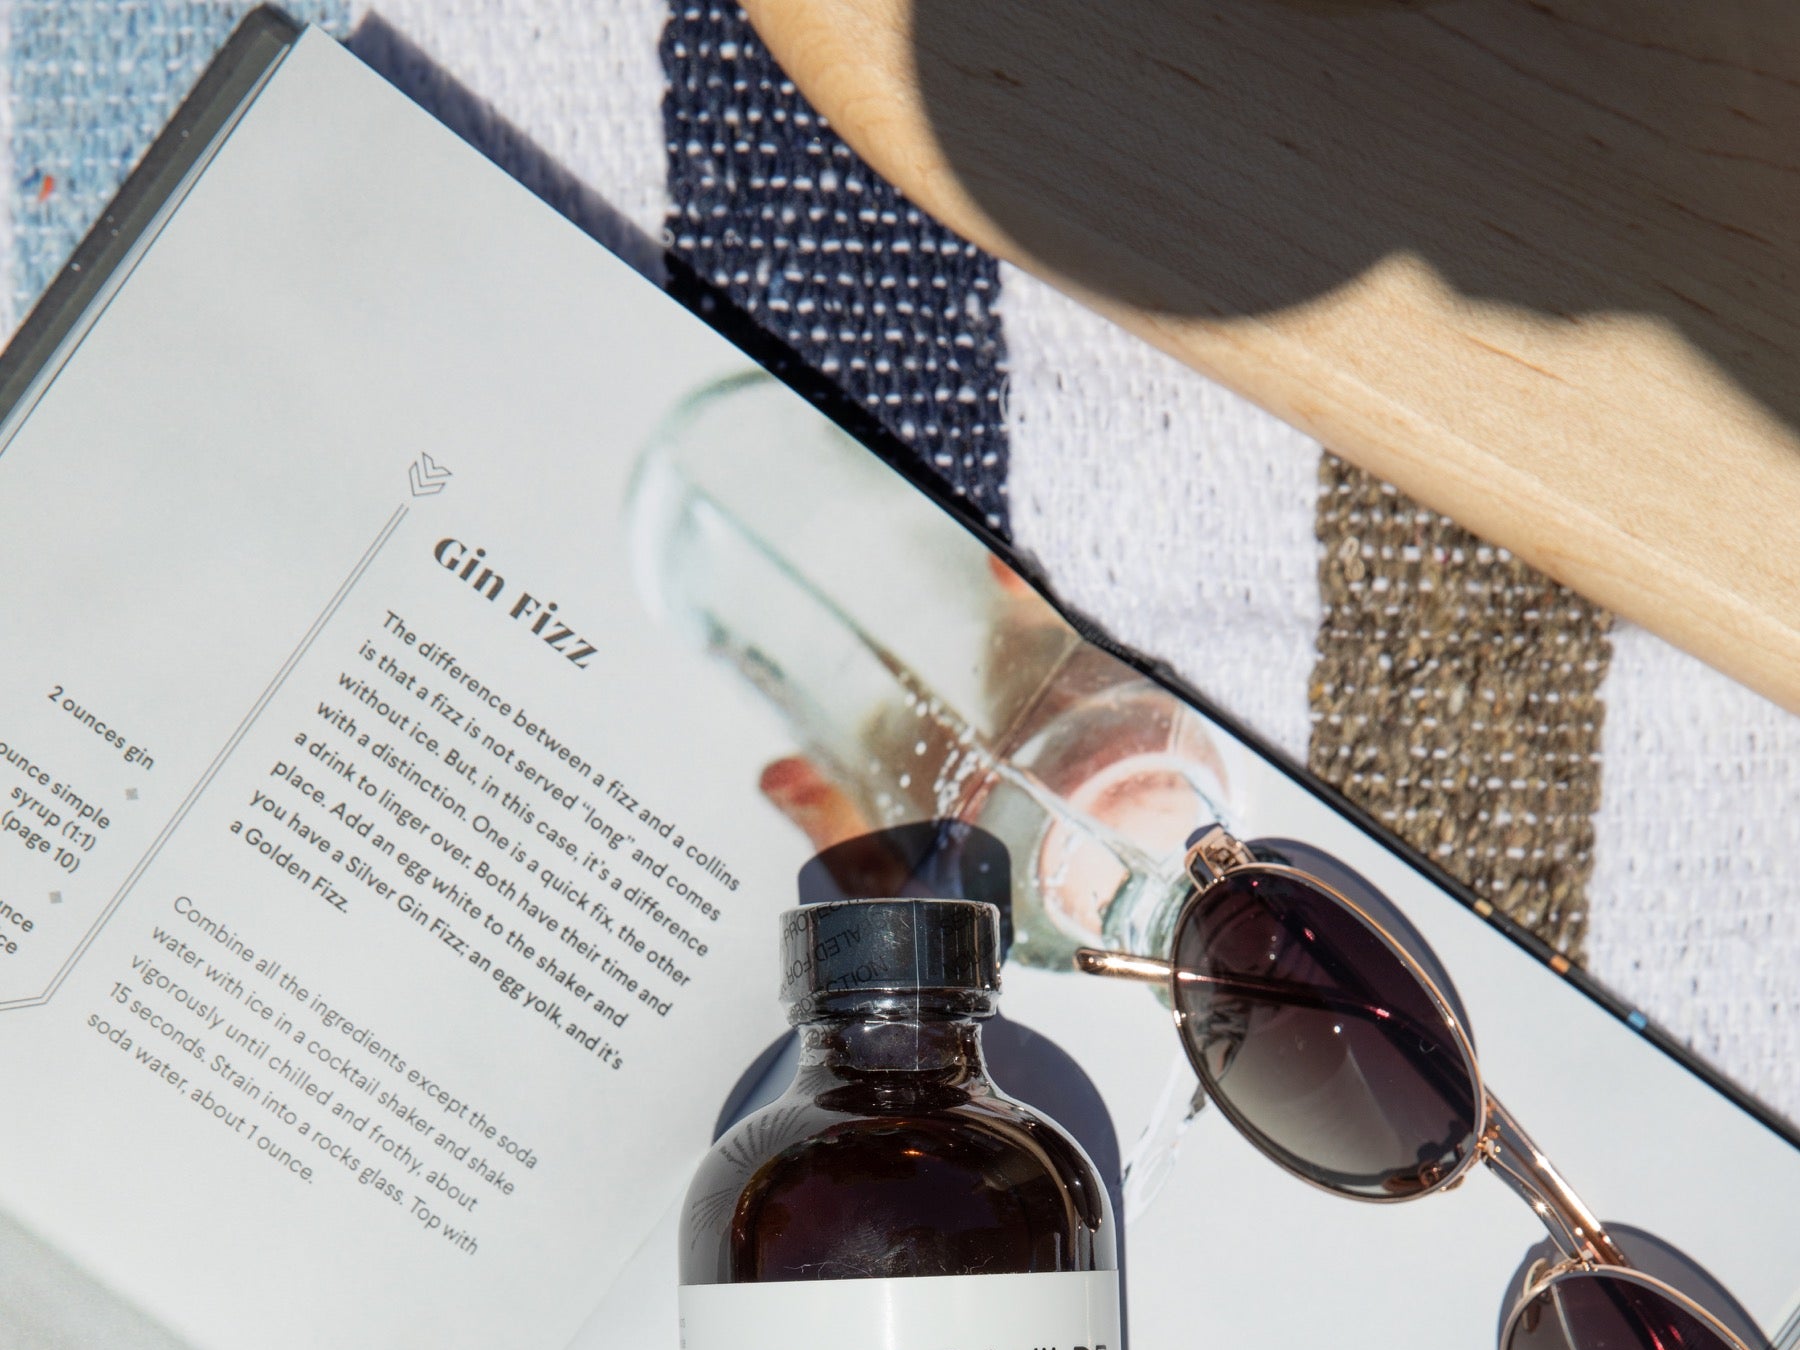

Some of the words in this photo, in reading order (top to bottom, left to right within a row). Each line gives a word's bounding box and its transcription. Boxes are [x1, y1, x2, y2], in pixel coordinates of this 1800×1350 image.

[47, 684, 64, 703] 2
[61, 698, 127, 750] ounces
[123, 745, 155, 771] gin
[433, 537, 505, 603] Gin
[508, 592, 599, 670] Fizz
[1, 810, 51, 853] (page
[52, 847, 81, 874] 10)
[10, 786, 61, 828] syrup
[61, 820, 97, 852] (1:1)
[51, 782, 110, 830] simple
[229, 820, 244, 835] a
[244, 827, 311, 884] Golden
[310, 875, 349, 914] Fizz.
[294, 732, 308, 747] a
[308, 742, 357, 783] drink
[356, 775, 378, 798] to
[378, 788, 431, 835] linger
[429, 832, 473, 870] over.
[473, 860, 517, 902] Both
[516, 891, 559, 932] have
[559, 926, 602, 963] their
[600, 957, 639, 993] time
[637, 988, 674, 1018] and
[317, 701, 358, 738] with
[356, 733, 371, 748] a
[371, 743, 467, 822] distinction.
[472, 814, 510, 850] One
[509, 841, 527, 864] is
[526, 859, 540, 874] a
[540, 869, 590, 912] quick
[589, 902, 614, 934] fix,
[617, 924, 646, 954] the
[645, 949, 691, 987] other
[338, 672, 410, 732] without
[408, 721, 440, 757] ice.
[443, 747, 478, 786] But,
[480, 774, 500, 799] in
[501, 791, 536, 825] this
[536, 821, 578, 862] case,
[609, 877, 623, 892] a
[623, 887, 709, 957] difference
[358, 639, 377, 662] is
[377, 654, 417, 692] that
[415, 686, 429, 701] a
[429, 692, 465, 727] fizz
[463, 717, 482, 740] is
[481, 734, 516, 765] not
[514, 759, 580, 811] served
[631, 848, 669, 879] and
[665, 874, 721, 922] comes
[383, 609, 417, 646] The
[417, 642, 512, 717] difference
[512, 708, 592, 778] between
[592, 773, 606, 788] a
[605, 779, 640, 814] fizz
[638, 808, 676, 840] and
[672, 835, 685, 849] a
[685, 845, 741, 892] collins
[0, 900, 34, 933] nce
[249, 789, 288, 822] you
[286, 812, 331, 853] have
[331, 849, 345, 864] a
[345, 855, 398, 900] Silver
[397, 894, 429, 926] Gin
[428, 917, 470, 957] Fizz;
[467, 950, 492, 973] an
[491, 967, 527, 1001] egg
[521, 991, 563, 1030] yolk,
[564, 1022, 602, 1052] and
[269, 760, 326, 808] place.
[328, 801, 375, 839] Add
[371, 834, 396, 857] an
[396, 852, 433, 886] egg
[431, 876, 482, 920] white
[483, 913, 504, 936] to
[505, 930, 536, 960] the
[535, 955, 595, 1003] shaker
[592, 999, 630, 1028] and
[87, 1014, 133, 1052] soda
[135, 1046, 189, 1095] water,
[190, 1088, 246, 1133] about
[246, 1124, 259, 1140] 1
[257, 1136, 313, 1184] ounce.
[110, 981, 133, 1004] 15
[129, 1000, 206, 1063] seconds.
[210, 1054, 261, 1100] Strain
[261, 1090, 298, 1126] into
[297, 1122, 311, 1136] a
[311, 1131, 361, 1172] rocks
[357, 1167, 404, 1206] glass.
[410, 1195, 441, 1229] Top
[442, 1224, 478, 1256] with
[131, 955, 225, 1030] vigorously
[225, 1024, 271, 1060] until
[268, 1056, 334, 1106] chilled
[331, 1102, 371, 1132] and
[368, 1124, 424, 1176] frothy,
[425, 1170, 478, 1212] about
[152, 926, 205, 969] water
[205, 964, 244, 1000] with
[244, 991, 274, 1021] ice
[274, 1012, 293, 1035] in
[293, 1030, 306, 1045] a
[307, 1040, 381, 1096] cocktail
[377, 1091, 436, 1136] shaker
[433, 1133, 471, 1162] and
[467, 1156, 515, 1196] shake
[173, 895, 255, 963] Combine
[255, 959, 282, 980] all
[279, 972, 309, 1002] the
[309, 993, 407, 1073] ingredients
[407, 1069, 469, 1119] except
[468, 1111, 497, 1139] the
[496, 1135, 538, 1170] soda
